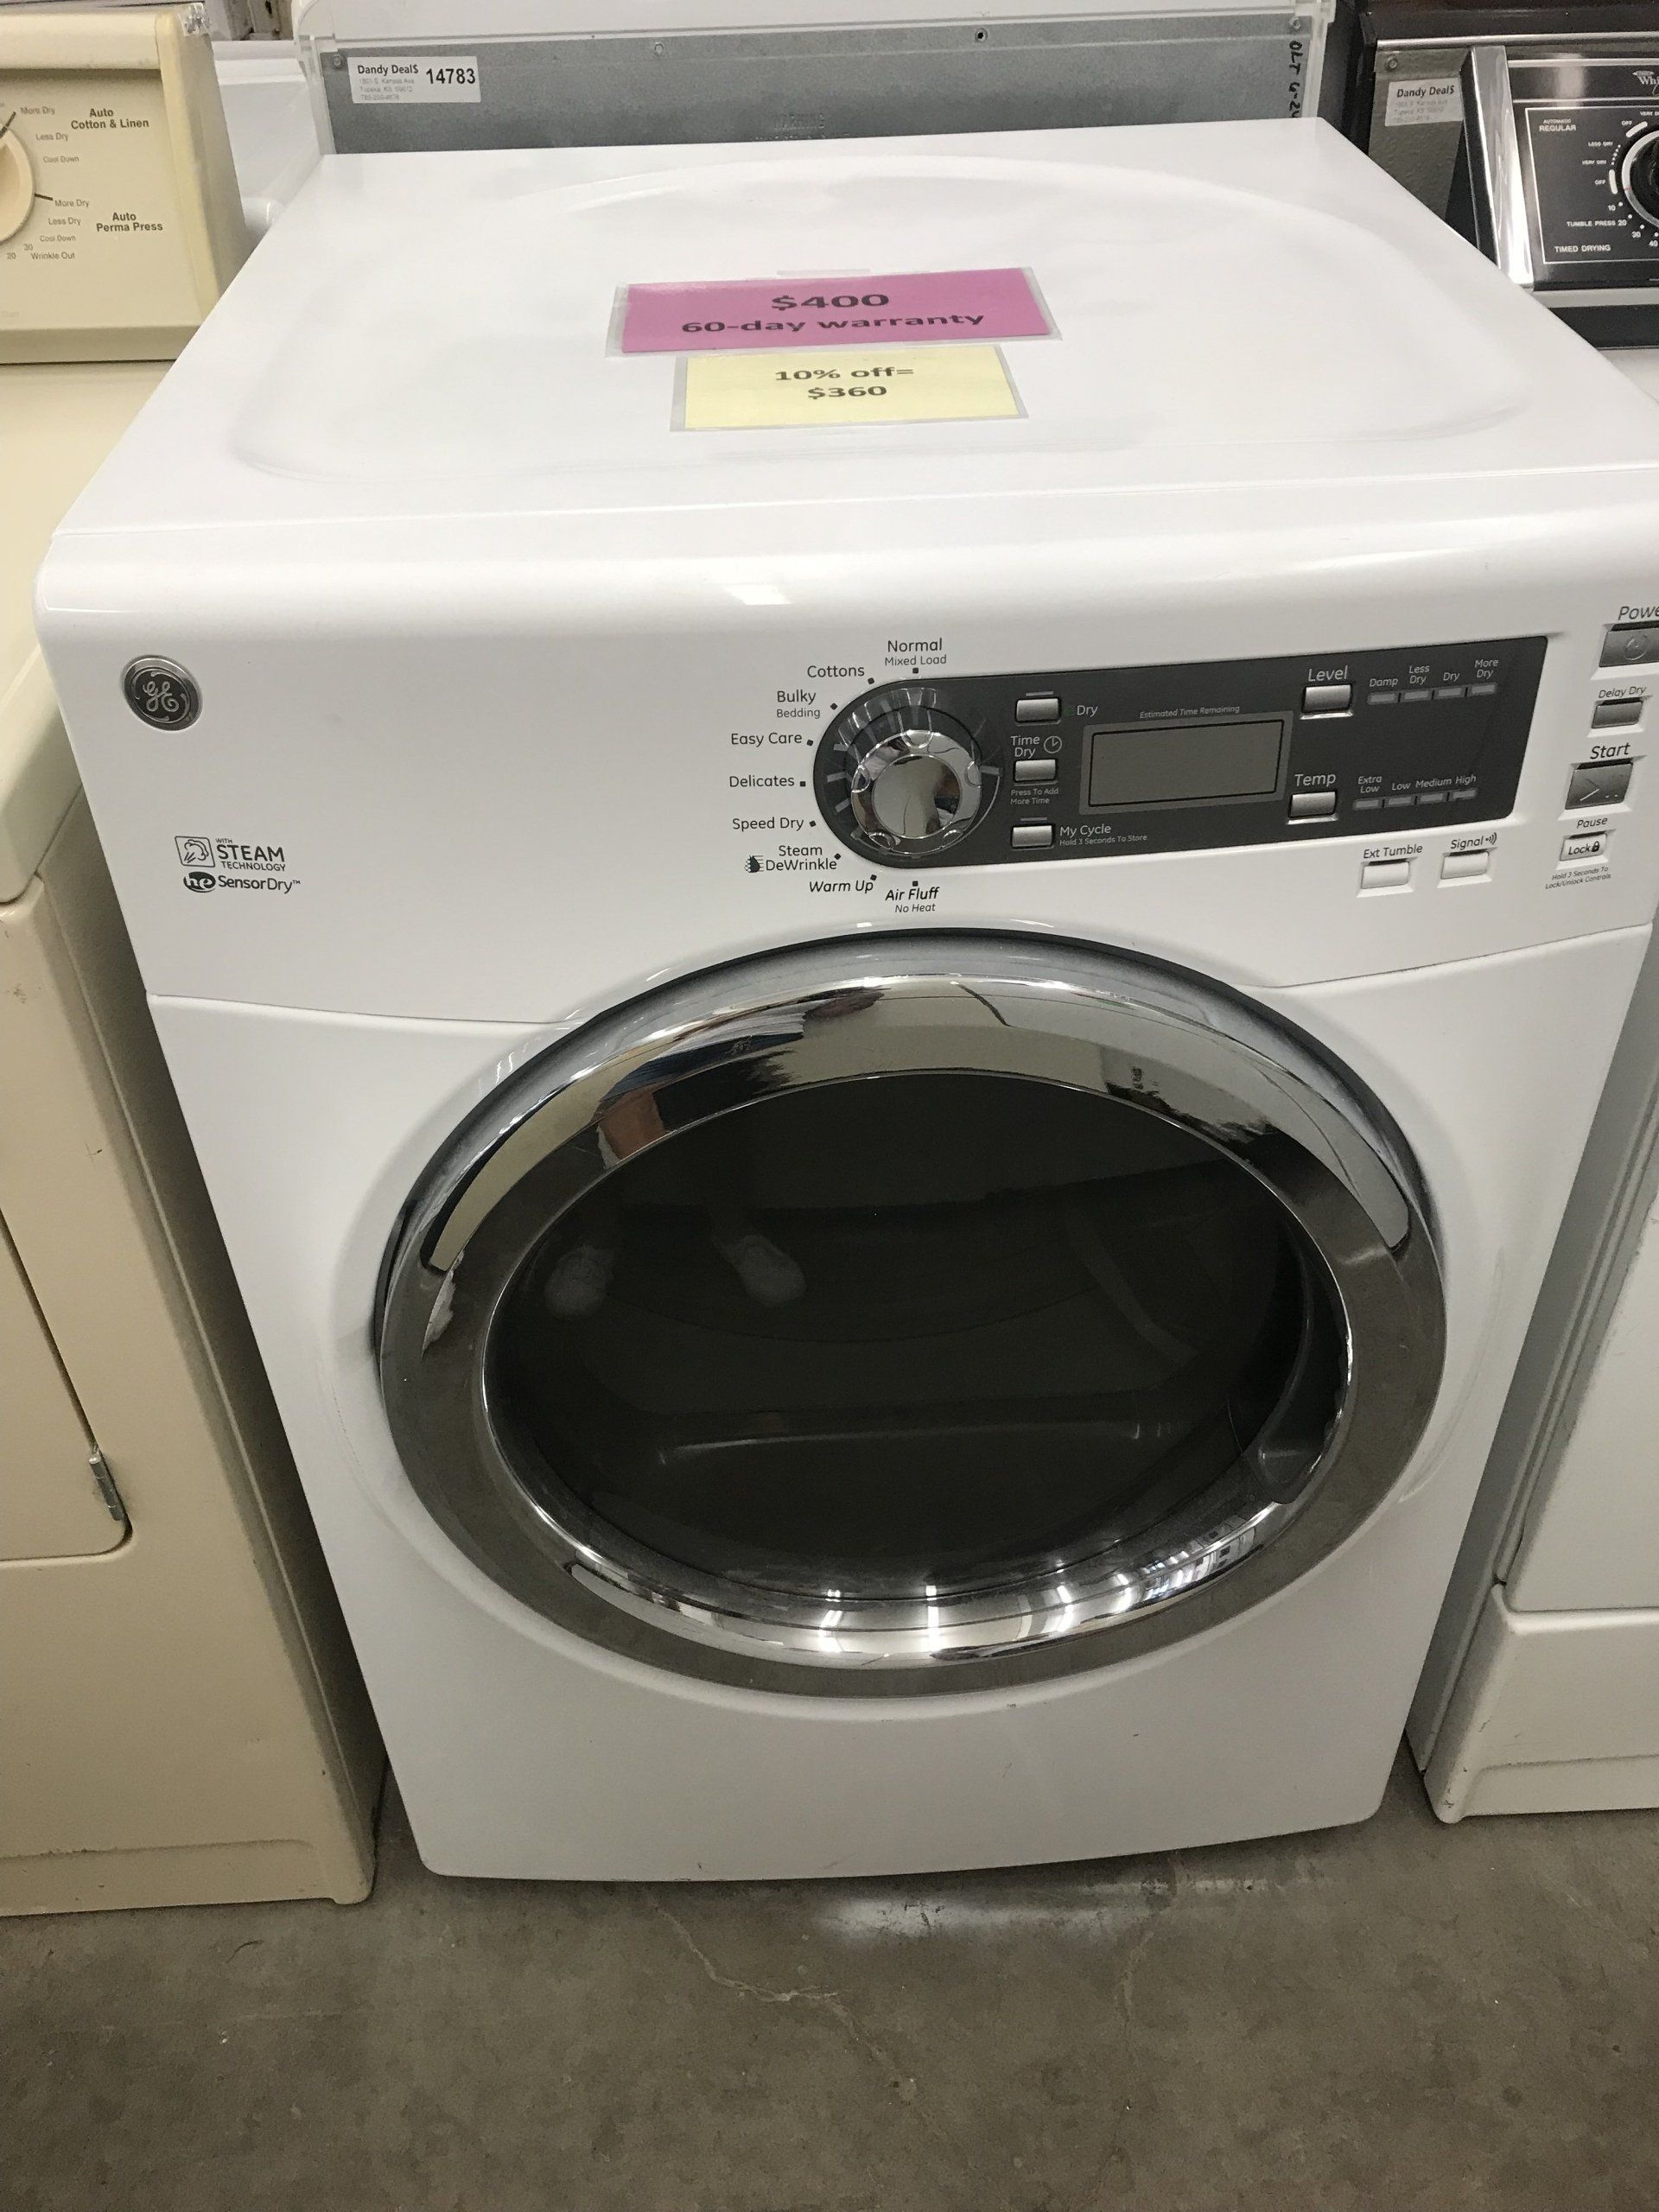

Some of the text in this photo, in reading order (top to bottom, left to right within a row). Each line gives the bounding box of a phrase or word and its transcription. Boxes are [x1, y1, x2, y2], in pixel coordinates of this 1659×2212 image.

[358, 64, 419, 76] Dandy Deal$
[426, 68, 476, 85] 14783
[1396, 85, 1455, 98] Dandy Deal$
[41, 106, 55, 115] Dry
[89, 108, 114, 118] Auto
[71, 118, 149, 130] Cotton & Linen
[55, 132, 69, 142] Dry
[76, 199, 89, 208] Dry
[67, 218, 81, 226] Dry
[112, 212, 137, 221] Auto
[97, 221, 163, 232] Perma Press
[772, 294, 890, 311] $400
[682, 314, 985, 334] 60-day warranty
[775, 366, 914, 382] 10% off=
[807, 385, 887, 400] $360
[1618, 606, 1659, 620] Powe
[887, 638, 943, 652] Normal
[885, 655, 947, 666] Mixed Load
[1475, 658, 1498, 668] More
[807, 665, 865, 678] Cottons
[1308, 665, 1349, 682] Level
[1409, 664, 1430, 674] Less
[1477, 669, 1494, 679] Dry
[1370, 677, 1398, 688] Damp
[1409, 675, 1427, 684] Dry
[1443, 671, 1460, 682] Dry
[777, 690, 817, 705] Bulky
[1599, 685, 1647, 699] Delay Dry
[776, 708, 821, 719] Bedding
[1077, 704, 1098, 717] Dry
[1140, 705, 1240, 719] Estimated Time Remaining
[731, 732, 803, 747] Easy Care
[1011, 735, 1040, 747] Time
[1014, 747, 1036, 759] Dry
[1590, 743, 1631, 760] Start
[729, 776, 795, 788] Delicates
[1294, 772, 1337, 787] Temp
[1357, 775, 1382, 785] Extra
[1415, 778, 1452, 788] Medium
[1455, 774, 1477, 785] High
[1360, 785, 1380, 793] Low
[1392, 782, 1411, 791] Low
[732, 817, 804, 832] Speed Dry
[1576, 817, 1608, 830] Pause
[1059, 823, 1111, 838] My Cycle
[1084, 836, 1116, 844] Seconds
[1451, 836, 1484, 849] Signal
[216, 844, 285, 862] STEAM
[779, 845, 823, 857] Steam
[1363, 844, 1423, 859] Ext Tumble
[1568, 845, 1591, 855] Lock
[221, 861, 286, 872] TECHNOLOGY
[766, 859, 837, 871] DeWrinkle
[1552, 872, 1566, 880] Hold
[1573, 868, 1599, 878] Seconds
[810, 880, 874, 893] Warm Up
[1545, 874, 1611, 890] Lock/Unlock Controls
[885, 887, 939, 900] Air Fluff
[894, 903, 936, 913] No Heat
